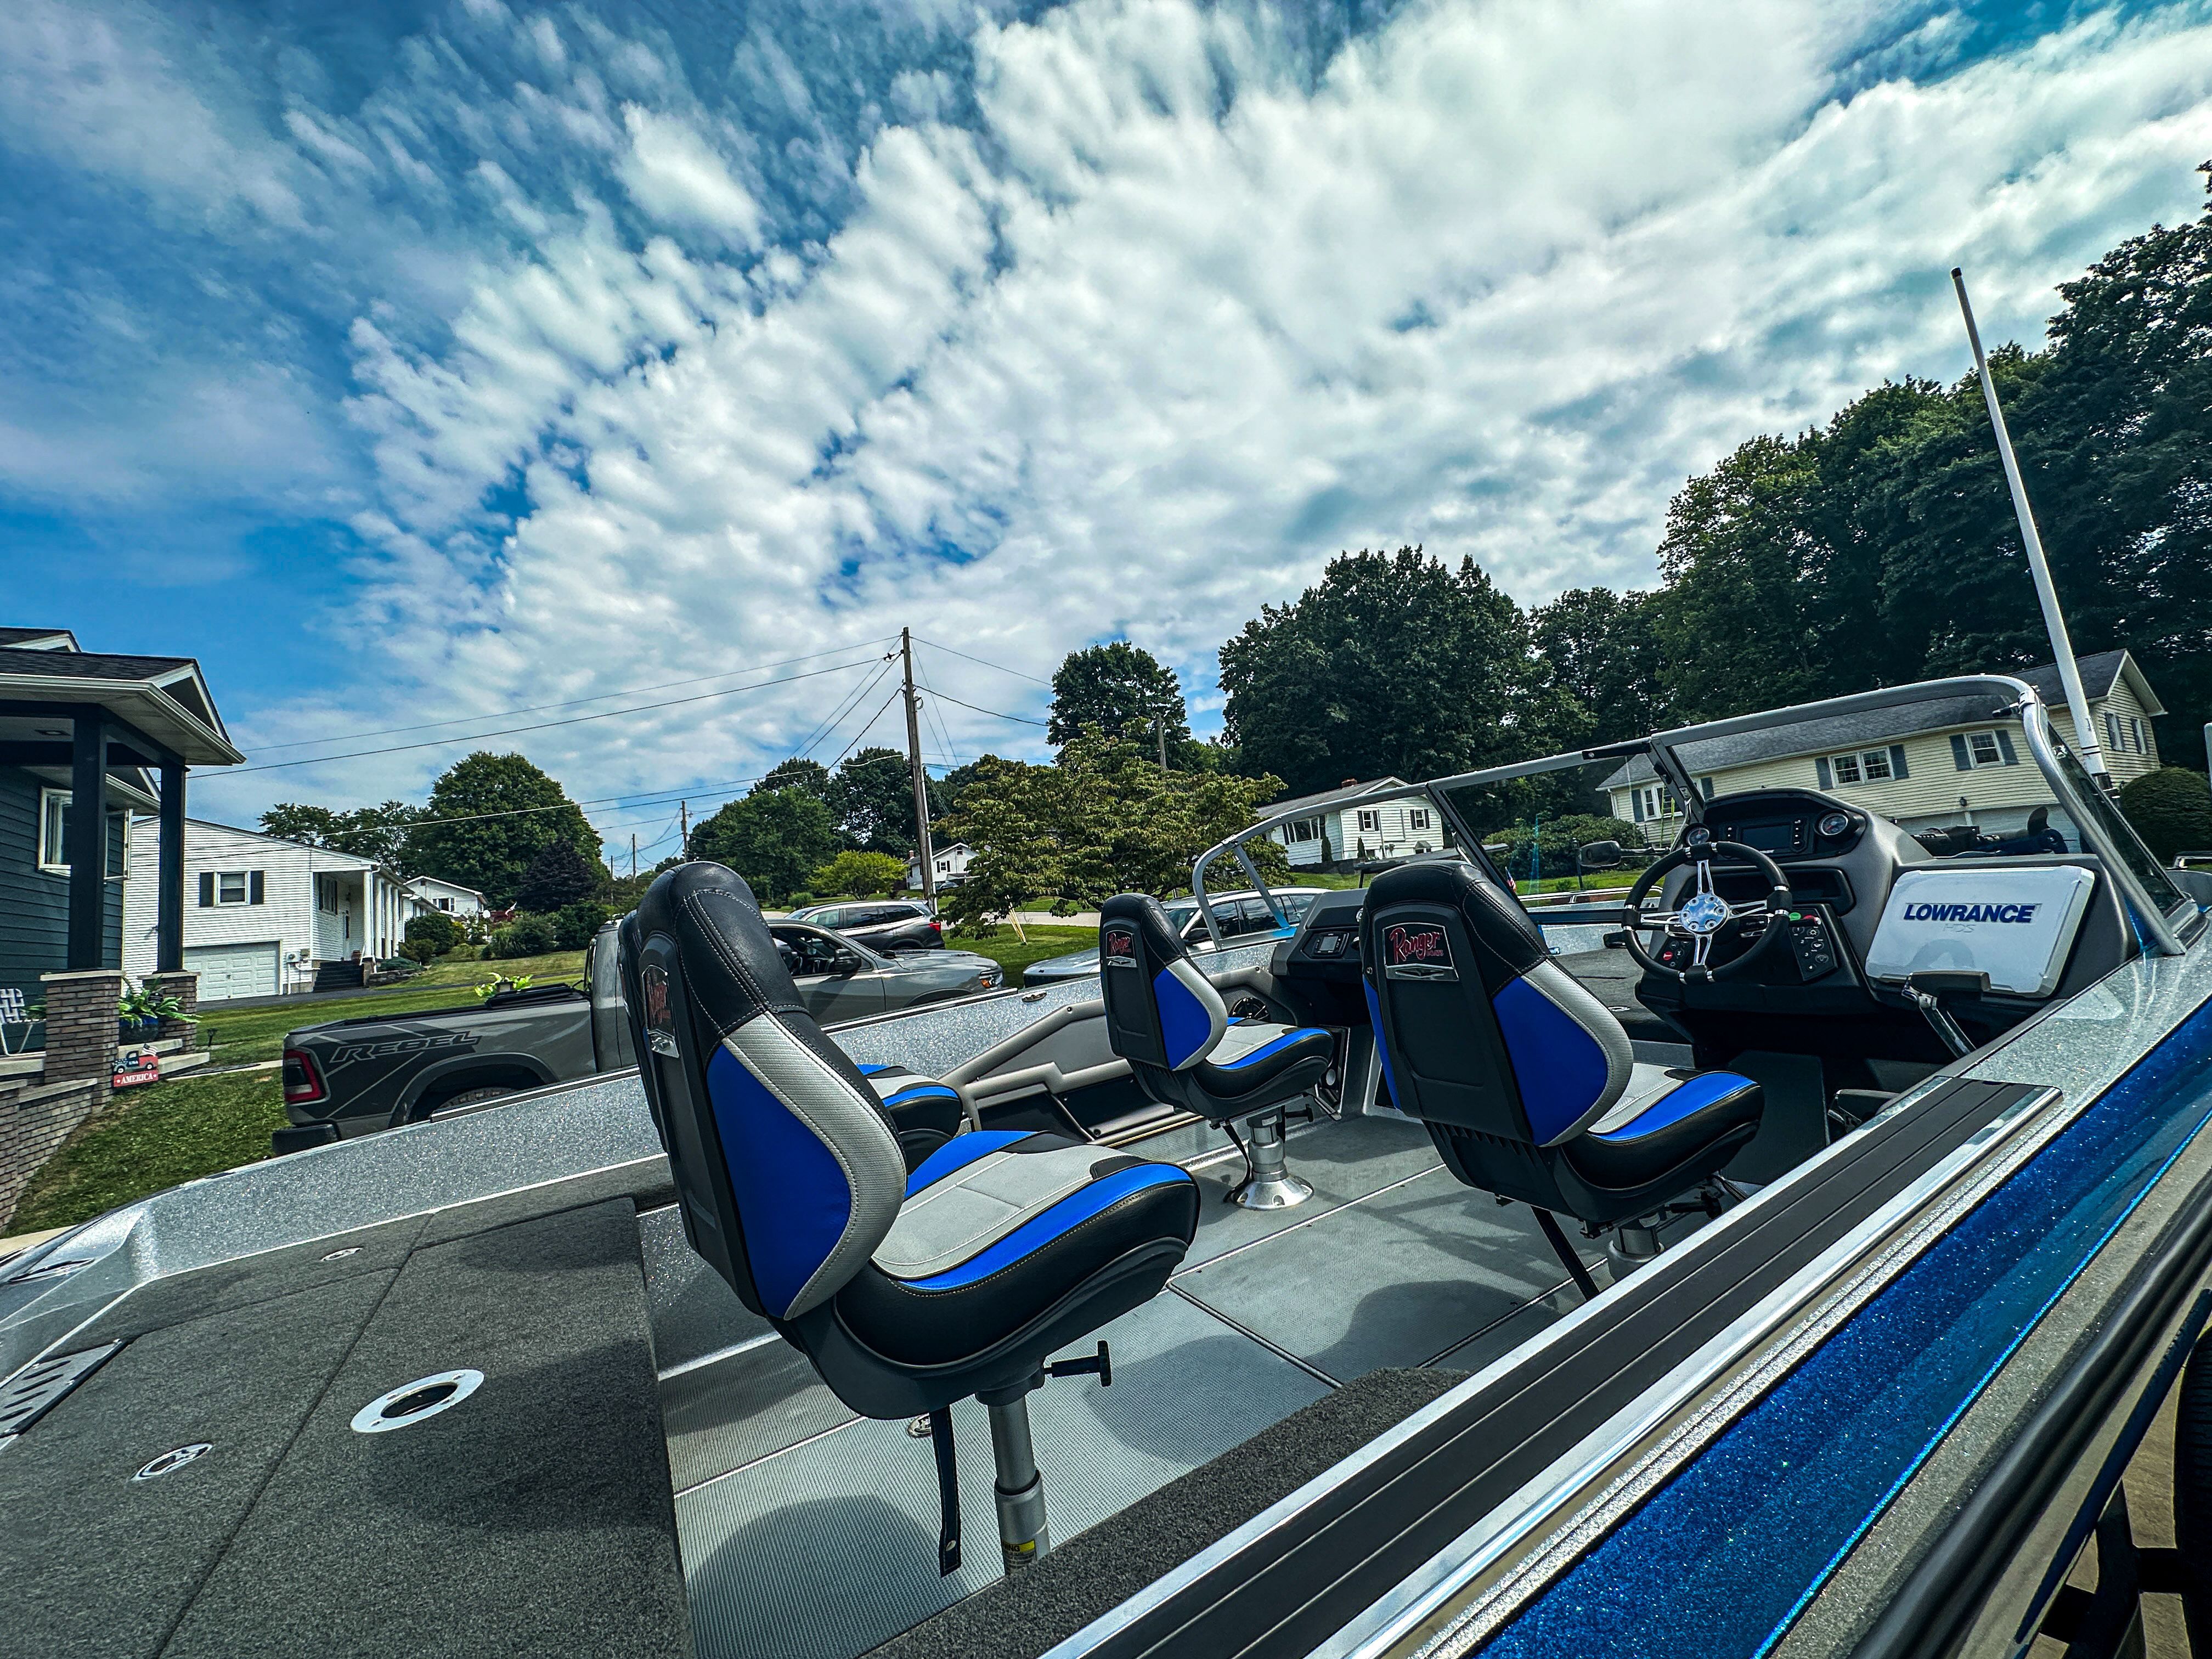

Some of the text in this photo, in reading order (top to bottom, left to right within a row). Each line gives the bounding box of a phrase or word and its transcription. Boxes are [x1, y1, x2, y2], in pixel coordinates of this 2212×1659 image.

[1903, 904, 2036, 923] LOWRANCE
[1943, 923, 1976, 933] HDS
[1389, 927, 1441, 964] Ranger
[329, 1031, 482, 1063] REBEL
[121, 1073, 154, 1085] AMERICA
